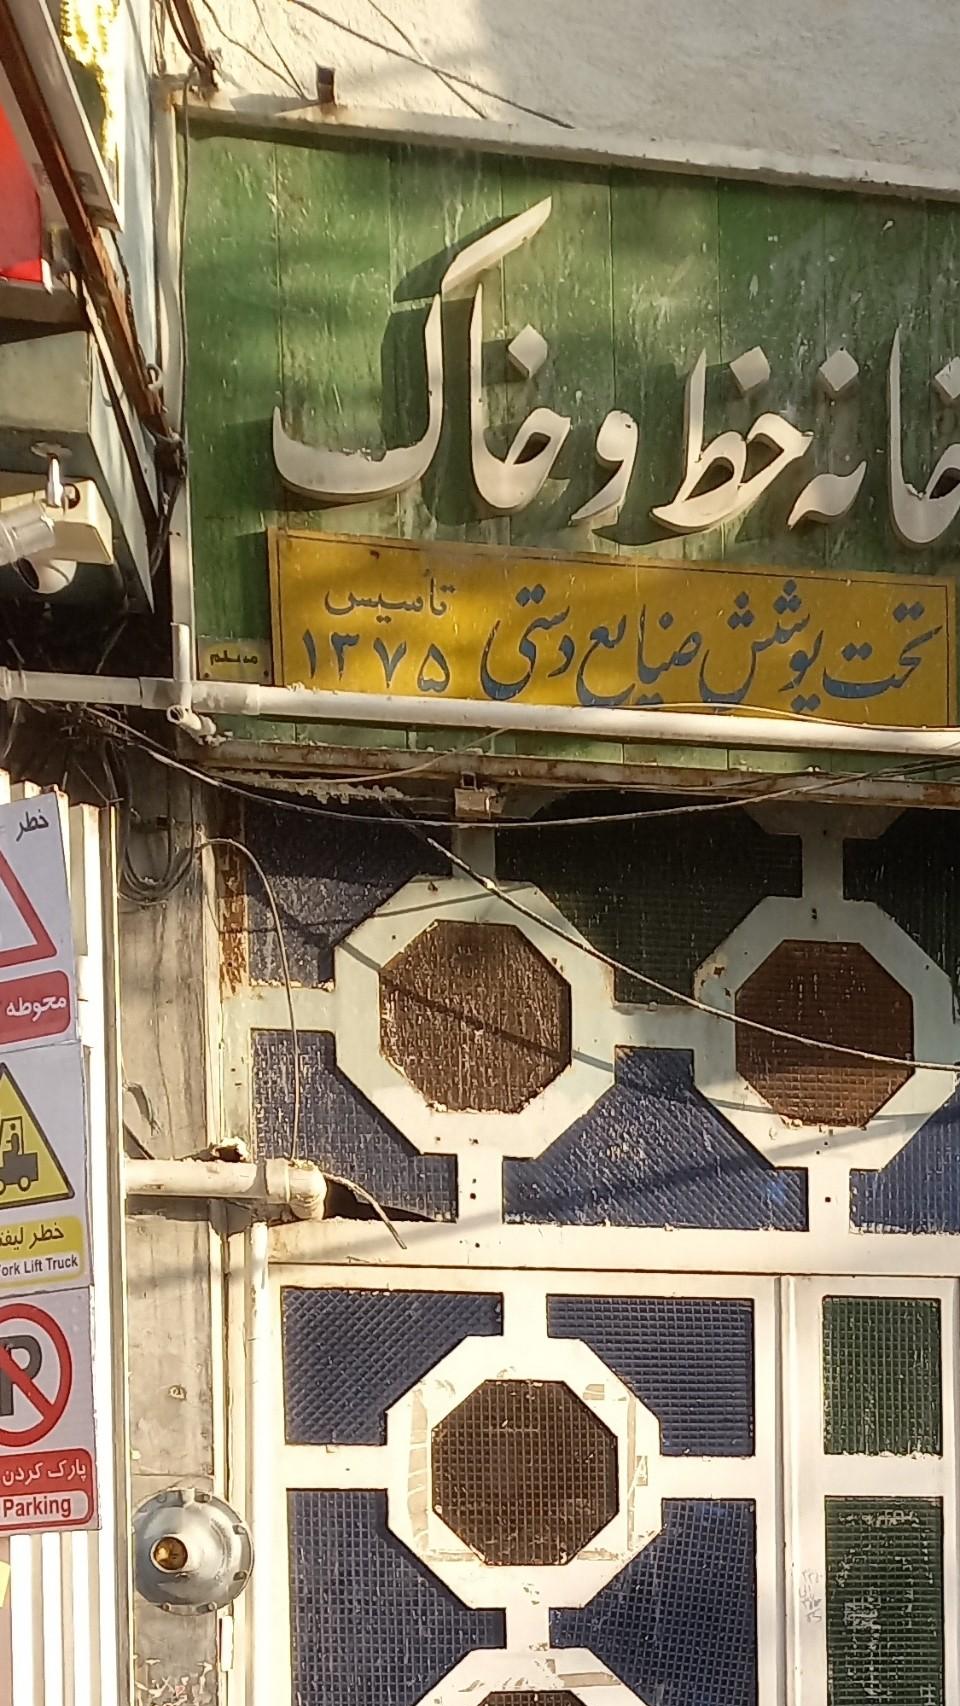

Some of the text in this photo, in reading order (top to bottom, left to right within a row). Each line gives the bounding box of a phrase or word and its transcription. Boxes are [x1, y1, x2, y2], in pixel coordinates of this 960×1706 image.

[272, 196, 571, 510] خاک
[651, 346, 814, 531] خط
[302, 627, 451, 693] ۱۳۷۵
[480, 578, 943, 712] تحت پوشش صنایع دستی
[16, 808, 50, 842] خطر
[6, 993, 68, 1023] محوطه
[28, 1221, 65, 1250] خطر
[0, 1254, 79, 1277] ork Lift Truck
[2, 1458, 87, 1487] پارک کردن
[3, 1495, 72, 1519] Parking
